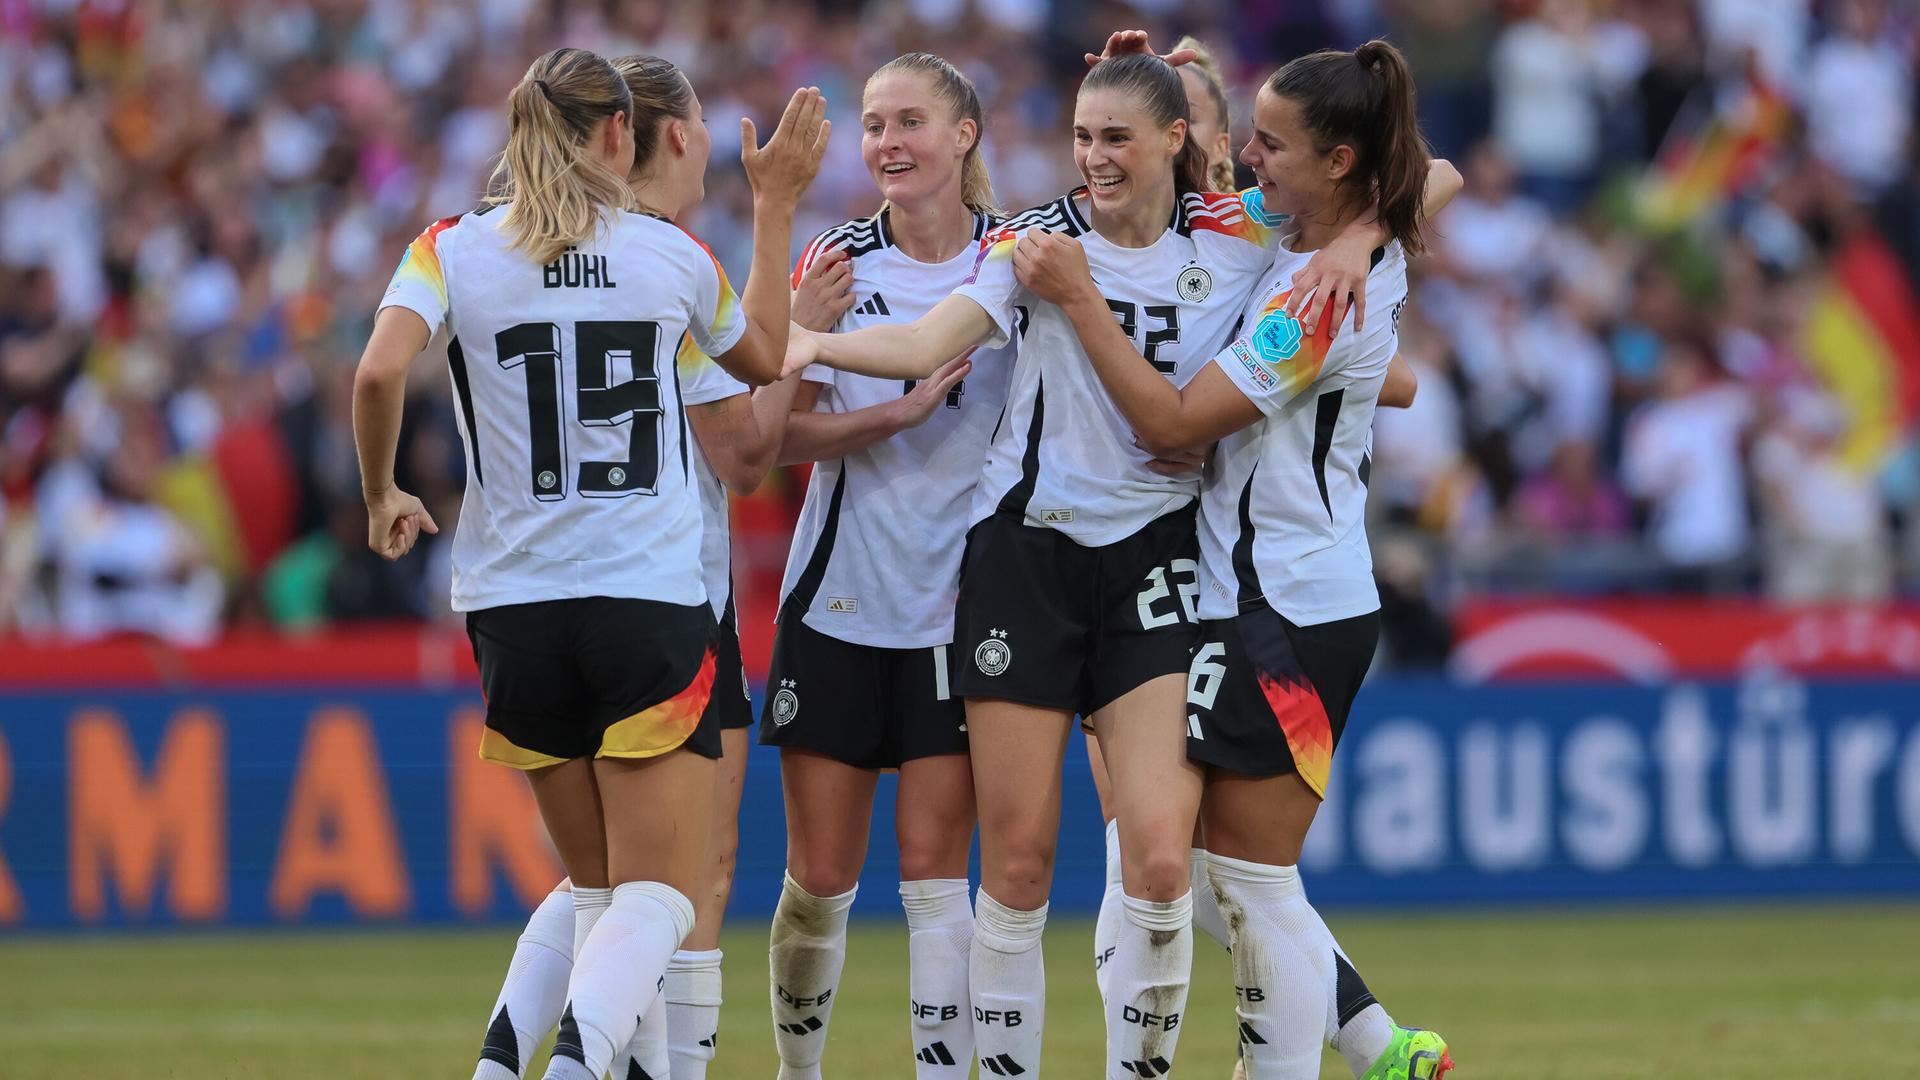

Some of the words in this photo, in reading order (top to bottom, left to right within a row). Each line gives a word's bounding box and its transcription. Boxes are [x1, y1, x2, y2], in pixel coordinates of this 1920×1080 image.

[543, 246, 617, 289] BÜHL
[1234, 341, 1275, 387] FOUNDATION
[494, 320, 664, 502] 19
[1137, 558, 1200, 631] 22
[777, 984, 832, 1009] DFB
[911, 1000, 959, 1022] DFB
[975, 1006, 1022, 1028] DFB
[1123, 1005, 1179, 1032] DFB
